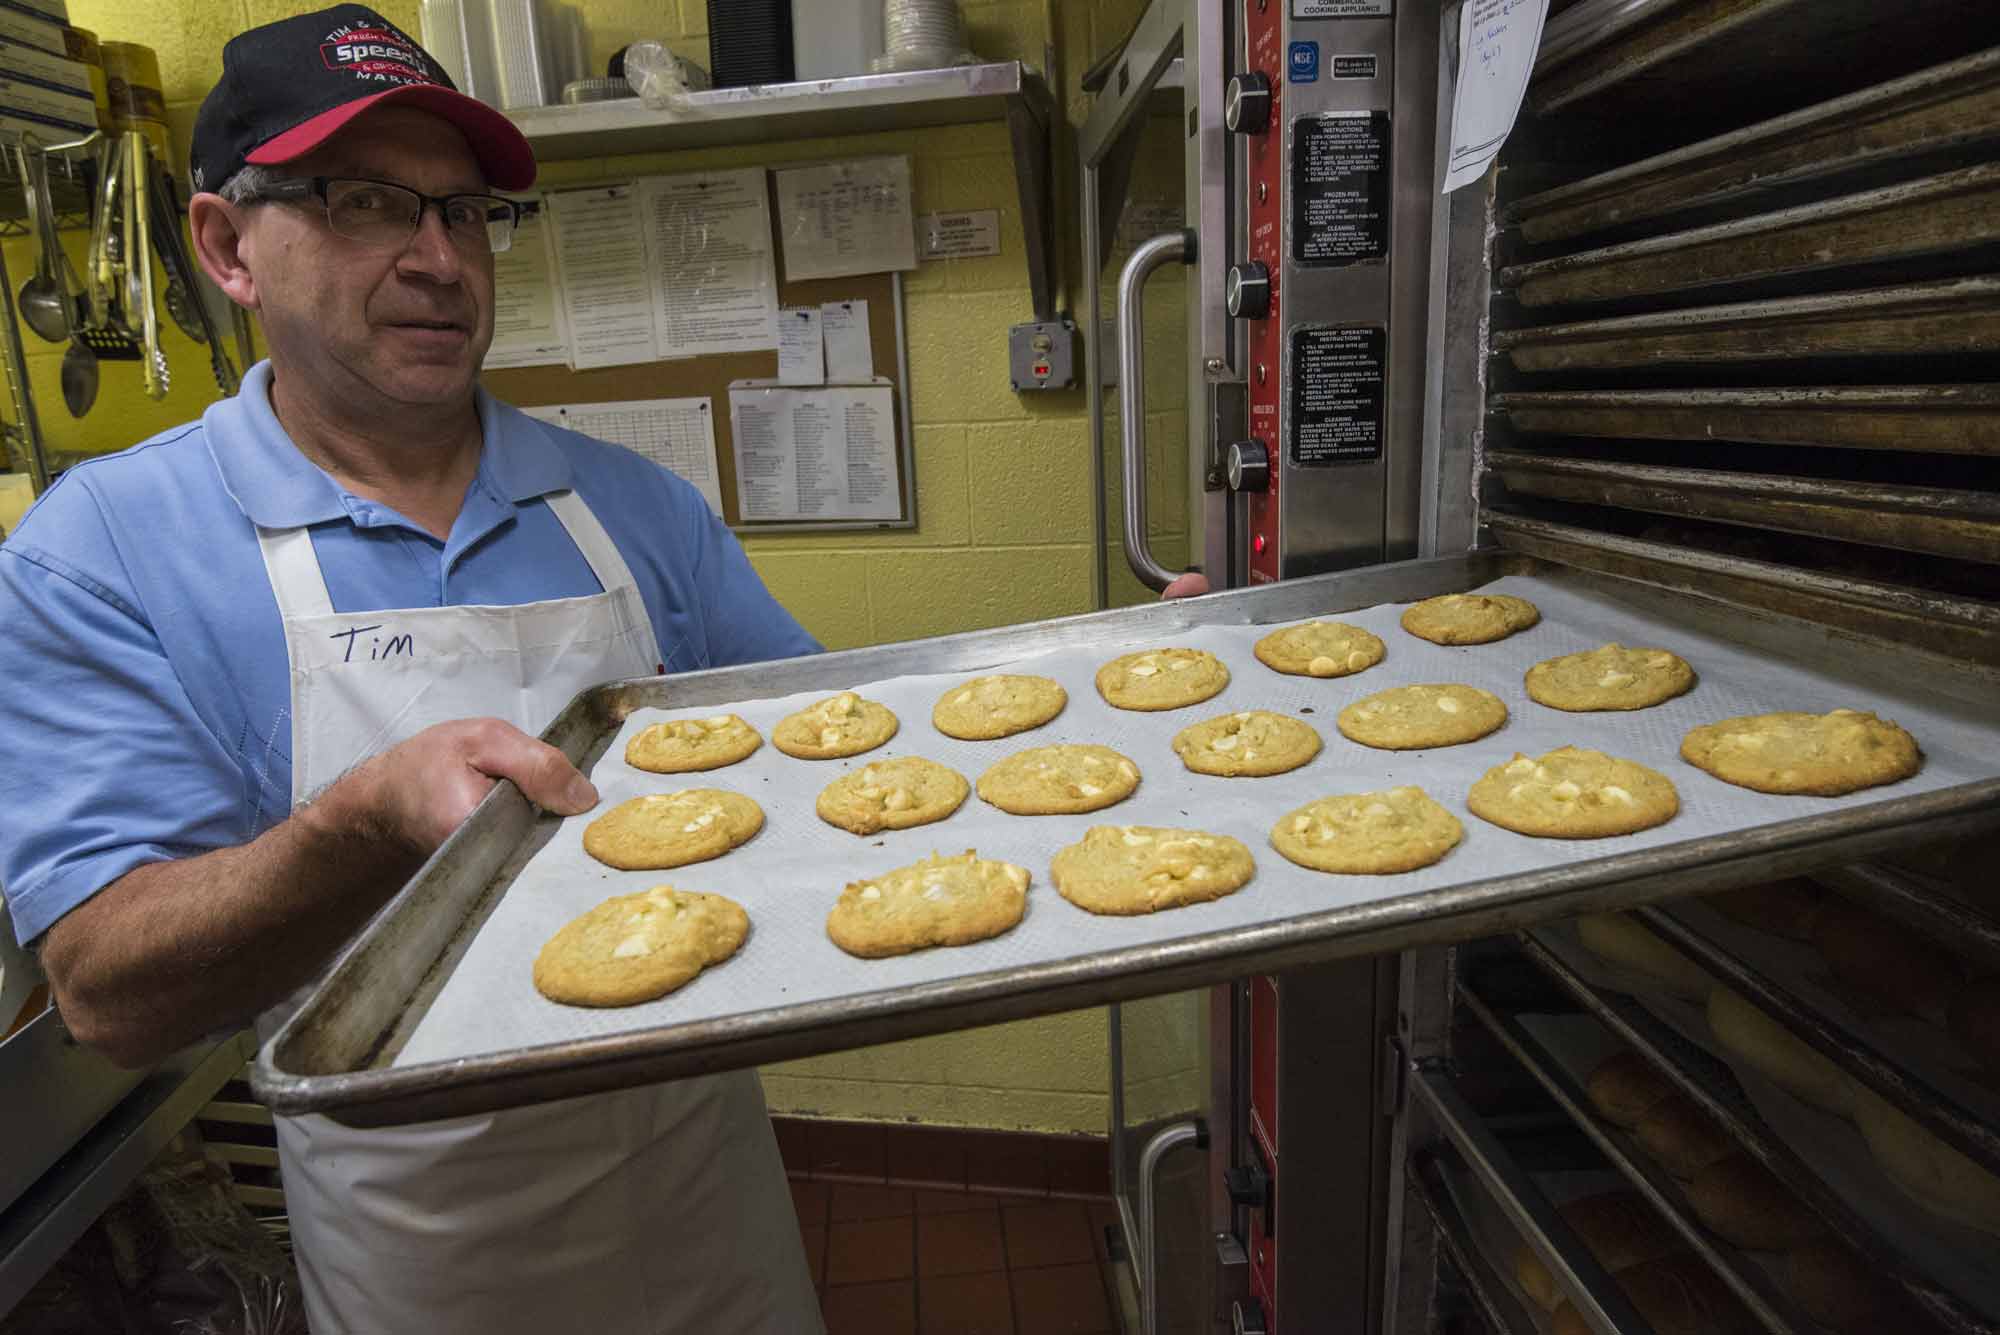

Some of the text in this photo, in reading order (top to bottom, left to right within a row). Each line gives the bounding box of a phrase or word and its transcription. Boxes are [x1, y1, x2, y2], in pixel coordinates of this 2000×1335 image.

[1304, 5, 1380, 14] COOKING APPLIANCE
[326, 25, 352, 42] TIM
